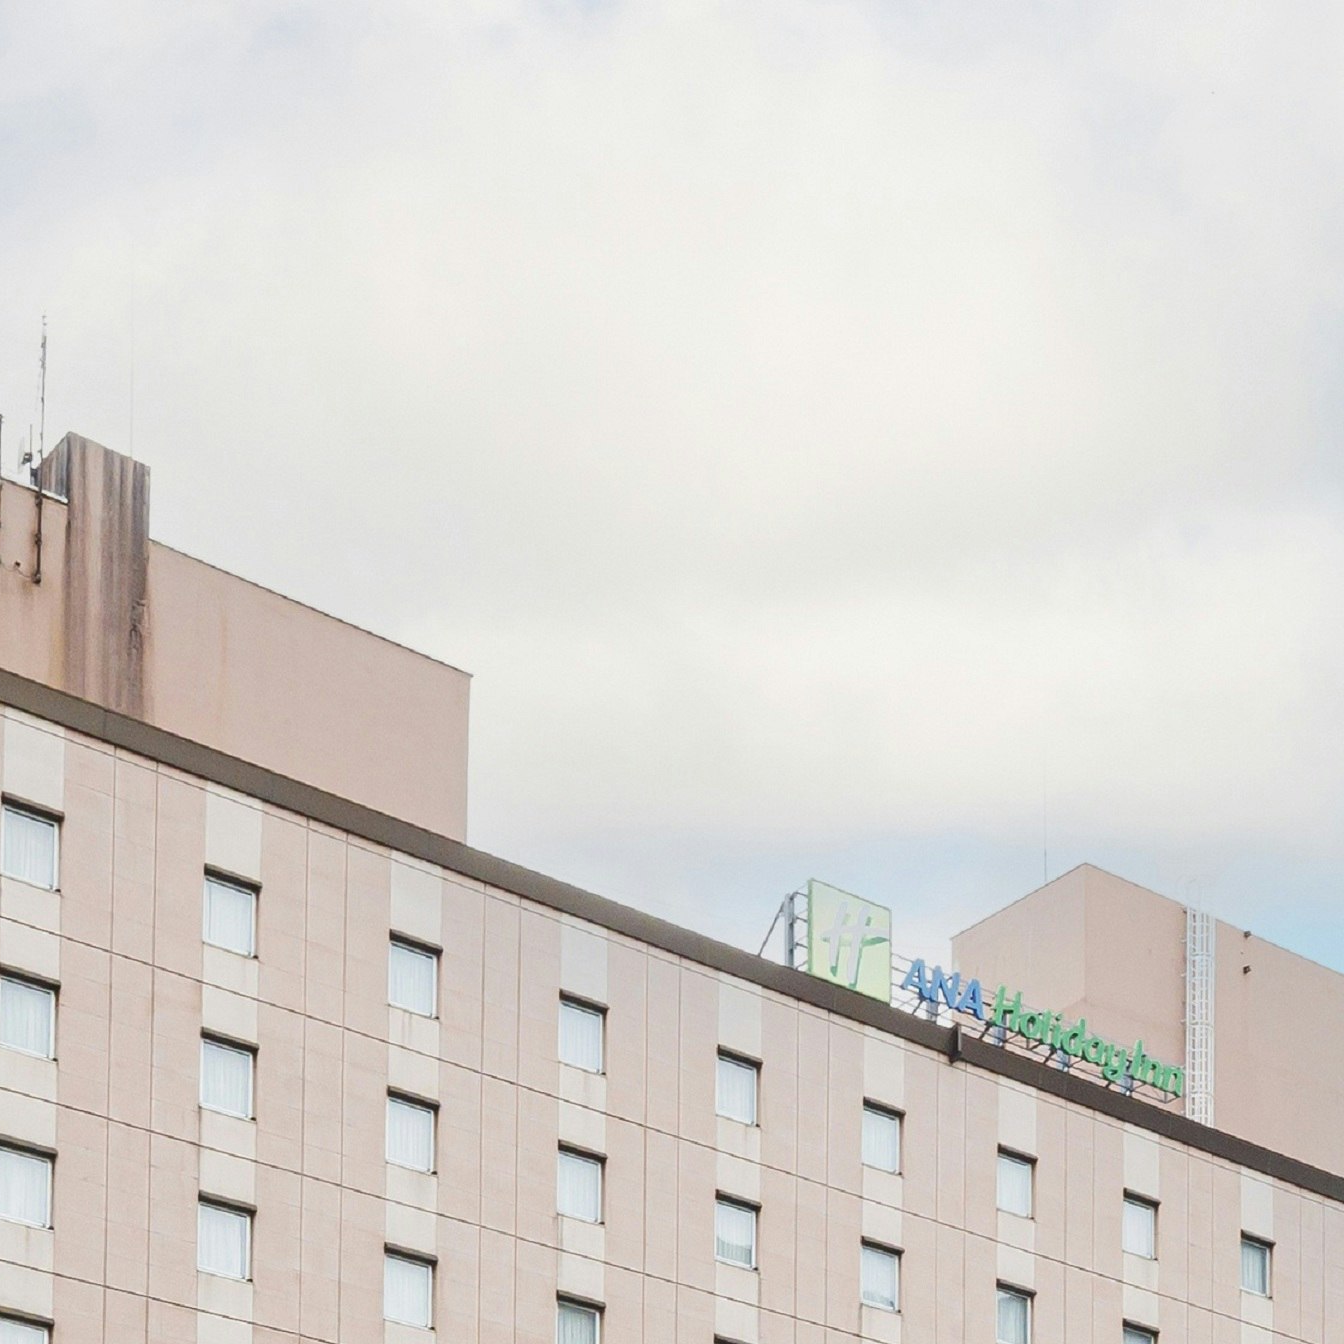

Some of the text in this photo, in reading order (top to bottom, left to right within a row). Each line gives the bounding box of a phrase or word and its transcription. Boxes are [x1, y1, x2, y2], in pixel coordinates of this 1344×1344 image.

[901, 958, 1185, 1098] ANA Holiday Inn
